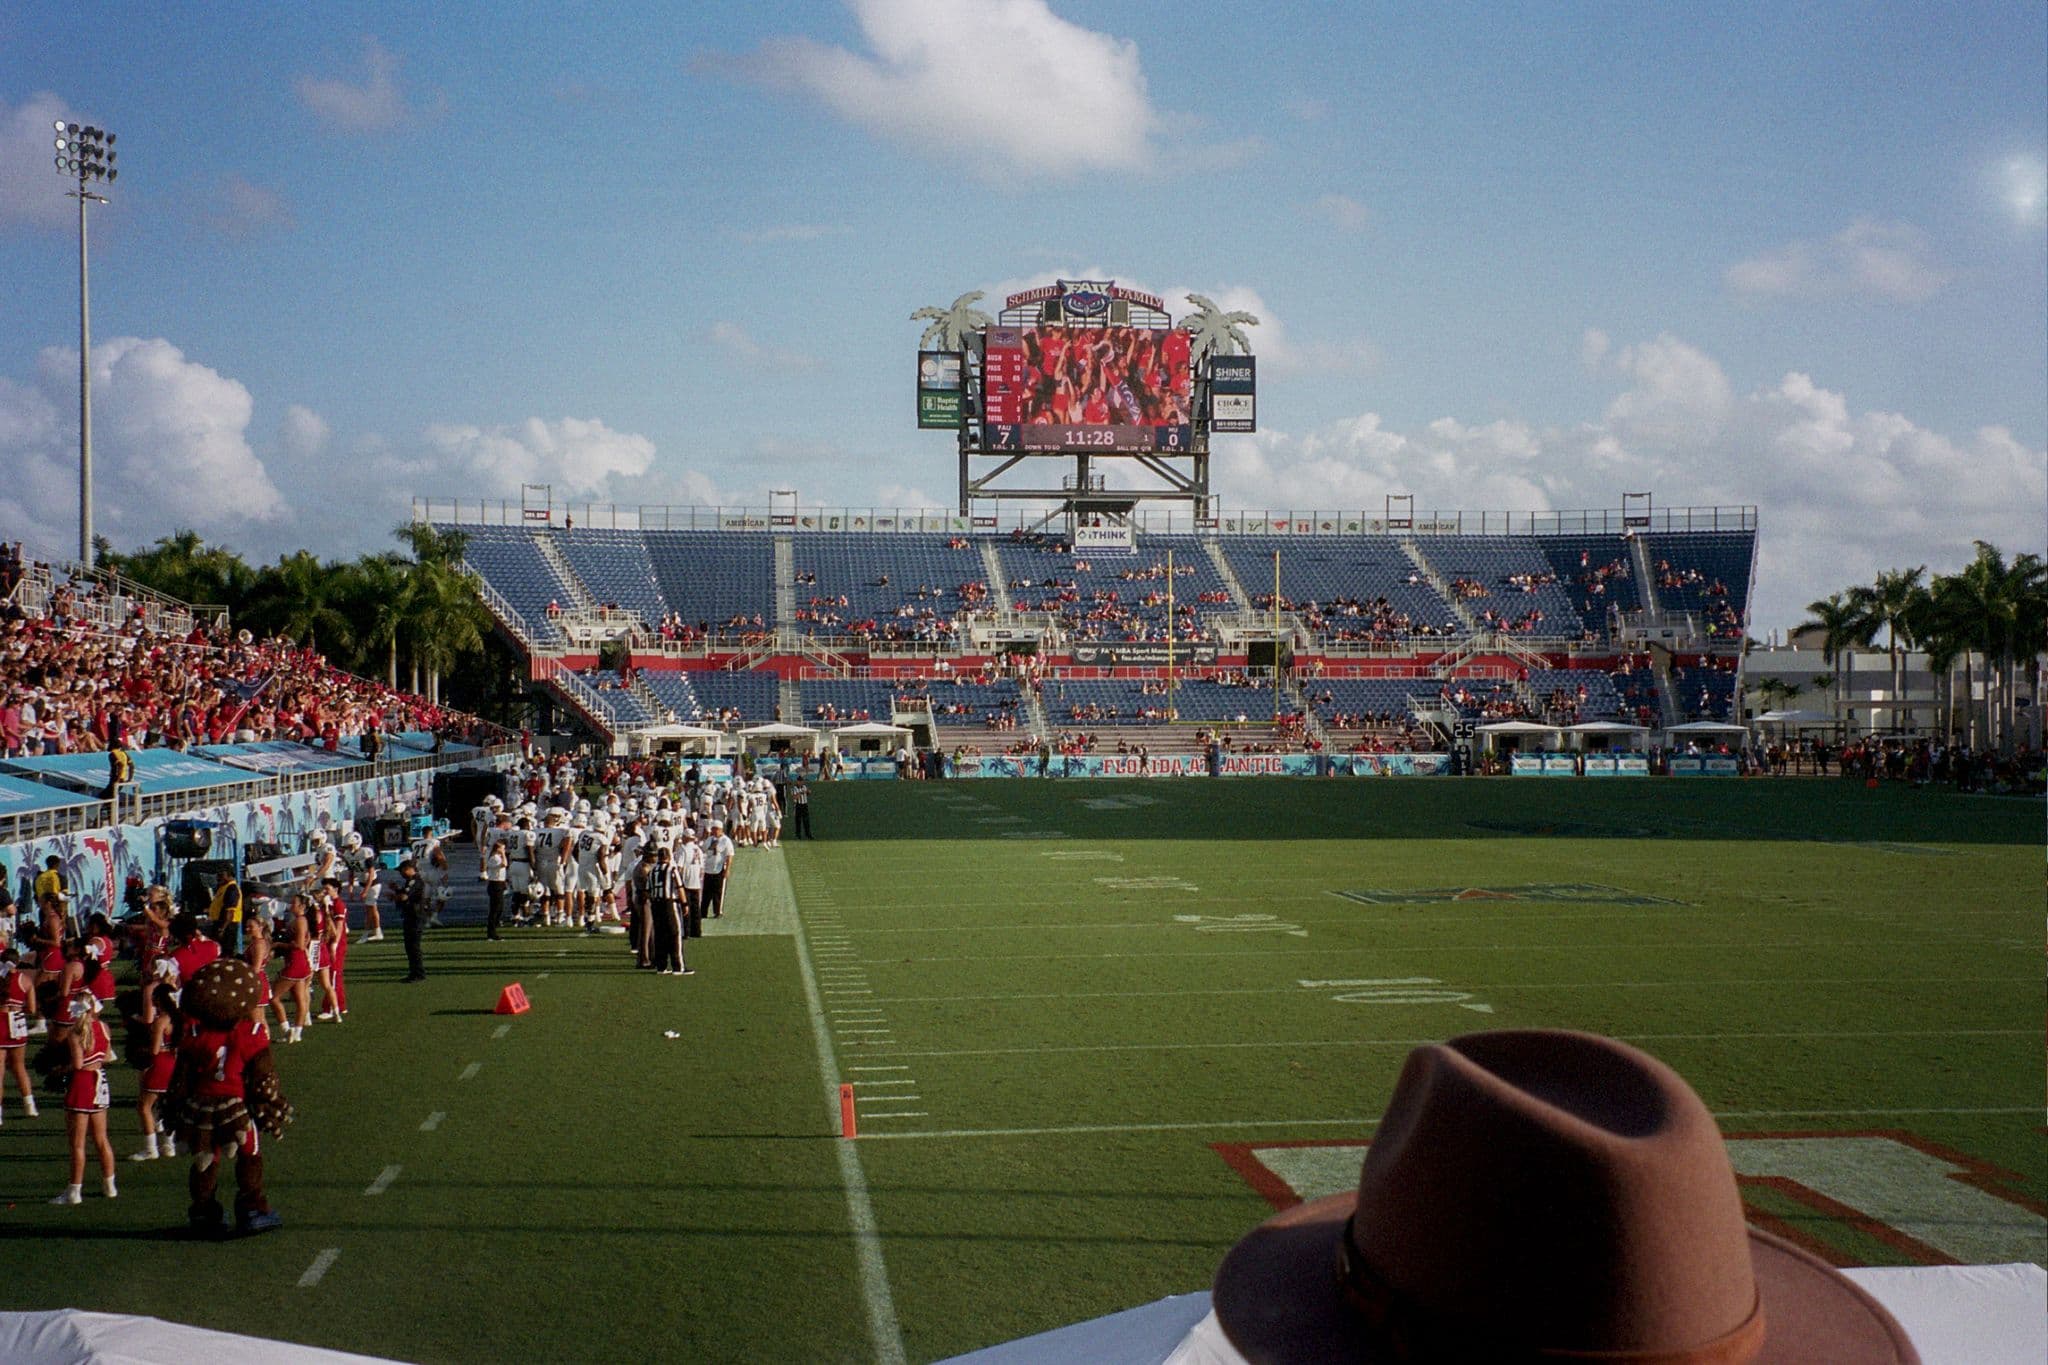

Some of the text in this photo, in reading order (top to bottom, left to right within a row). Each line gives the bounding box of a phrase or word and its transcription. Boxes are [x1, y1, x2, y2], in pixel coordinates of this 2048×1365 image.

[1008, 287, 1162, 307] SCHMIDT FAMILY
[1216, 368, 1251, 376] SHINER
[1000, 432, 1010, 444] 7
[1065, 431, 1114, 445] 11:28
[1169, 434, 1178, 446] 0
[1455, 723, 1474, 738] 25
[1103, 757, 1282, 774] FLOIDA ATANTIC
[539, 833, 553, 847] 74
[580, 834, 594, 851] 59
[662, 829, 670, 842] 3
[414, 844, 427, 858] 27
[215, 1046, 227, 1081] 1
